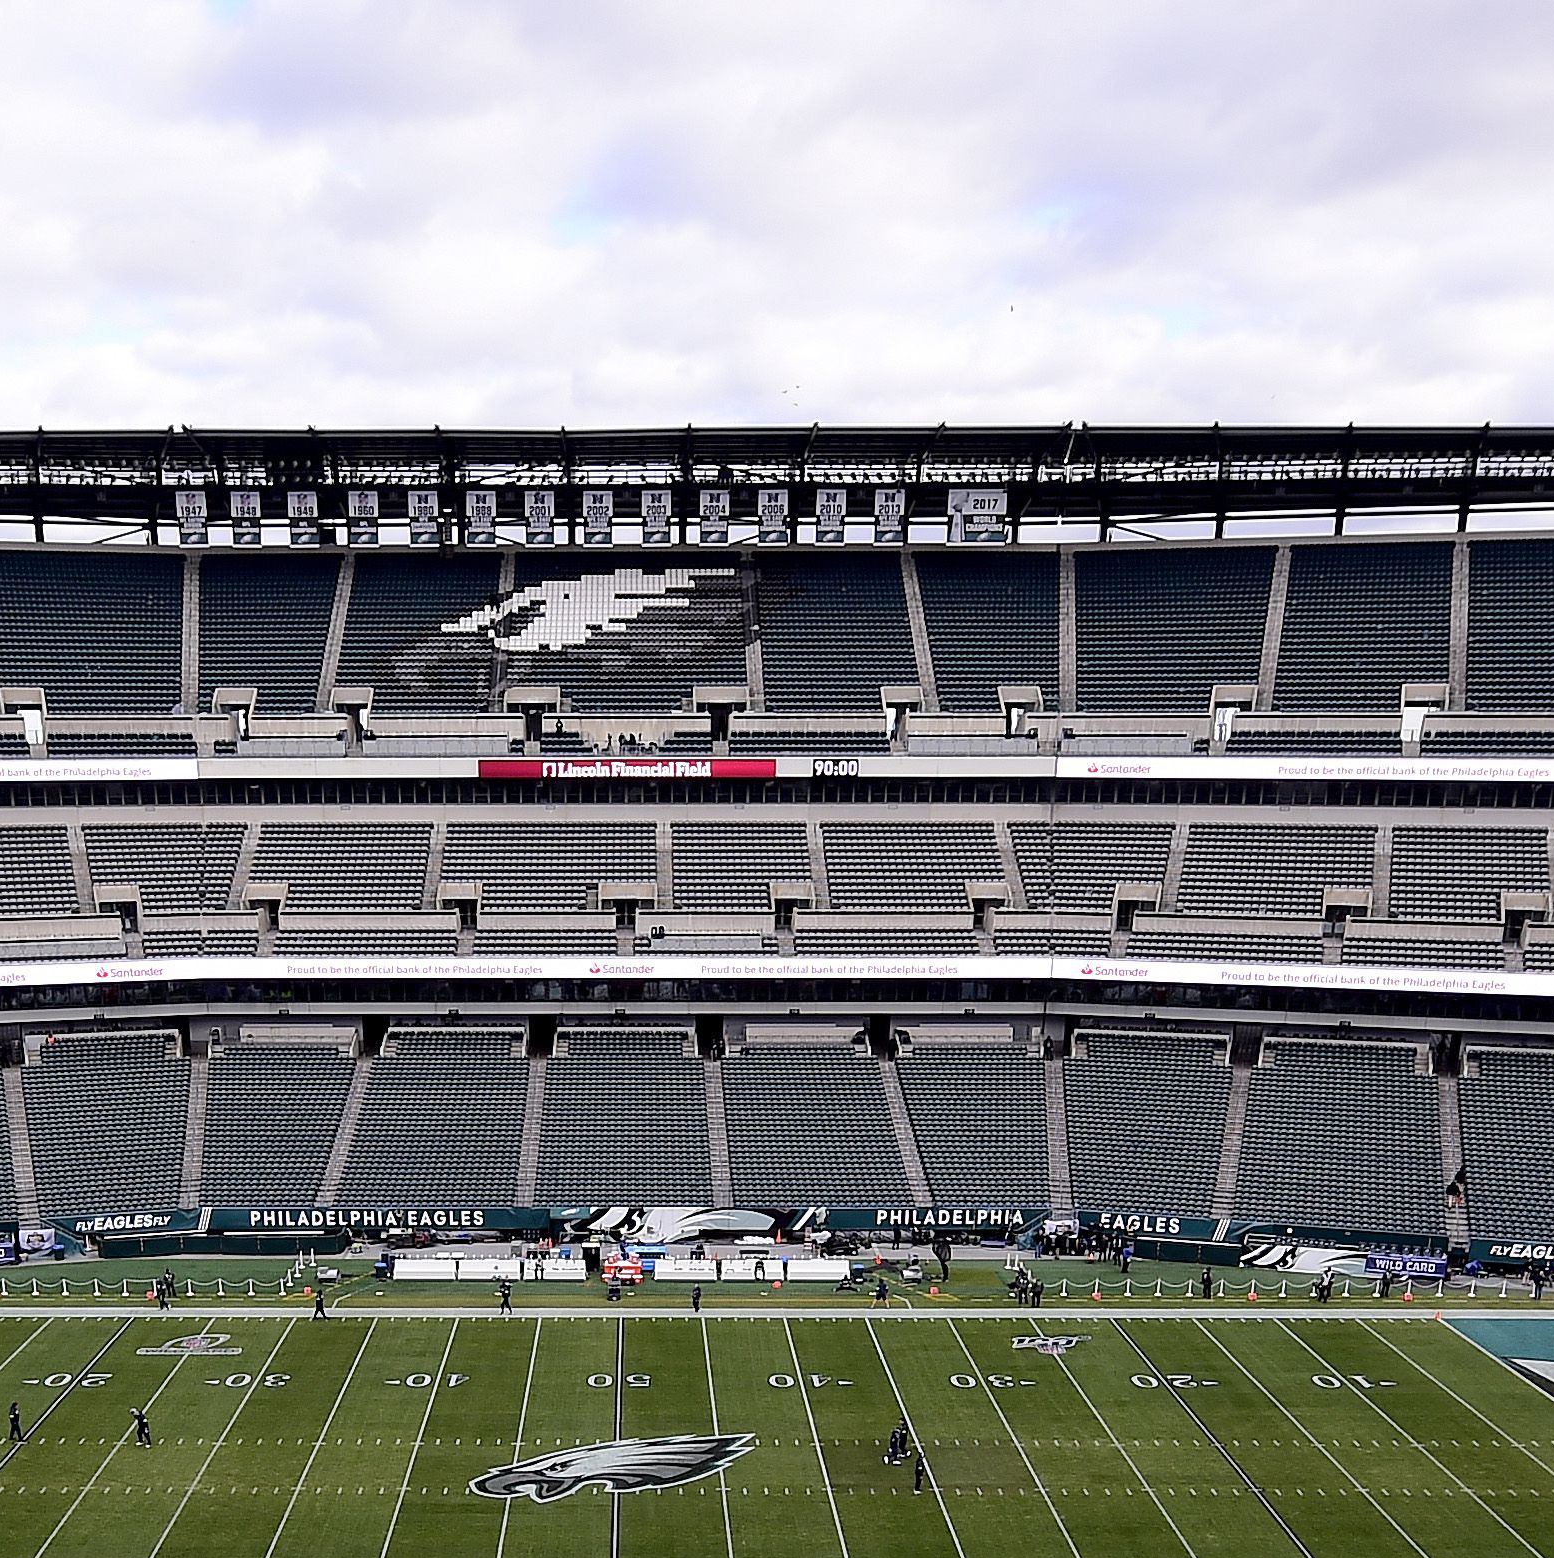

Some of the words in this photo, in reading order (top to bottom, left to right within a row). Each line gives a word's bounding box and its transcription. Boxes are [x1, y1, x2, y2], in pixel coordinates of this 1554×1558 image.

[586, 505, 610, 515] 2002
[646, 505, 667, 515] 2003
[702, 505, 726, 515] 2004
[761, 504, 785, 515] 2006
[819, 504, 842, 515] 2010
[878, 504, 900, 515] 2013
[972, 498, 998, 510] 2017
[180, 506, 202, 516] 1947
[292, 506, 314, 516] 1949
[352, 505, 374, 516] 1960
[528, 505, 551, 516] 2001
[7, 768, 30, 776] bank
[44, 768, 60, 776] the
[63, 767, 120, 778] Philadelphia
[122, 767, 151, 778] Eagles
[558, 761, 611, 777] Lincoln
[611, 761, 674, 777] Financial
[675, 761, 711, 777] Field
[813, 760, 858, 777] 90:00
[1100, 763, 1152, 775] Santander
[1278, 765, 1307, 774] Proud
[1322, 765, 1334, 774] be
[1337, 766, 1353, 774] the
[1355, 766, 1389, 775] official
[1391, 766, 1416, 775] bank
[1432, 767, 1448, 775] the
[1451, 767, 1514, 778] Philadelphia
[1517, 767, 1549, 779] Eagles
[110, 966, 164, 978] Santander
[286, 965, 315, 973] Proud
[329, 965, 341, 973] be
[343, 965, 359, 973] the
[362, 965, 393, 974] official
[396, 965, 419, 973] bank
[434, 965, 450, 974] the
[452, 964, 510, 976] Philadelphia
[513, 965, 542, 976] Eagles
[602, 963, 654, 975] Santander
[701, 965, 729, 973] Proud
[744, 965, 756, 973] be
[758, 965, 774, 973] the
[776, 964, 808, 973] official
[811, 964, 833, 973] bank
[849, 965, 864, 973] the
[867, 964, 925, 976] Philadelphia
[928, 964, 957, 976] Eagles
[1095, 966, 1149, 978] Santander
[1221, 971, 1251, 980] Proud
[1267, 972, 1280, 981] be
[1283, 973, 1300, 982] the
[1302, 973, 1337, 983] official
[1340, 975, 1365, 984] bank
[1382, 976, 1400, 985] the
[1403, 977, 1468, 990] Philadelphia
[1471, 979, 1505, 992] Eagles
[75, 1220, 94, 1232] FLY
[93, 1214, 154, 1231] EAGLES
[152, 1215, 171, 1227] FLY
[250, 1210, 397, 1227] PHILADELPHIA
[407, 1210, 485, 1227] EAGLES
[876, 1209, 1024, 1226] PHILADELPHIA
[1099, 1212, 1181, 1234] EAGLES
[1489, 1245, 1511, 1256] FLY
[1375, 1259, 1403, 1271] WILD
[1405, 1262, 1436, 1273] CARD
[43, 1373, 115, 1388] 20
[223, 1373, 293, 1388] 30
[404, 1373, 472, 1388] 40
[587, 1373, 652, 1388] 50
[768, 1373, 833, 1388] 40
[949, 1374, 1016, 1389] 30
[1130, 1374, 1198, 1389] 20
[1311, 1374, 1375, 1389] 10
